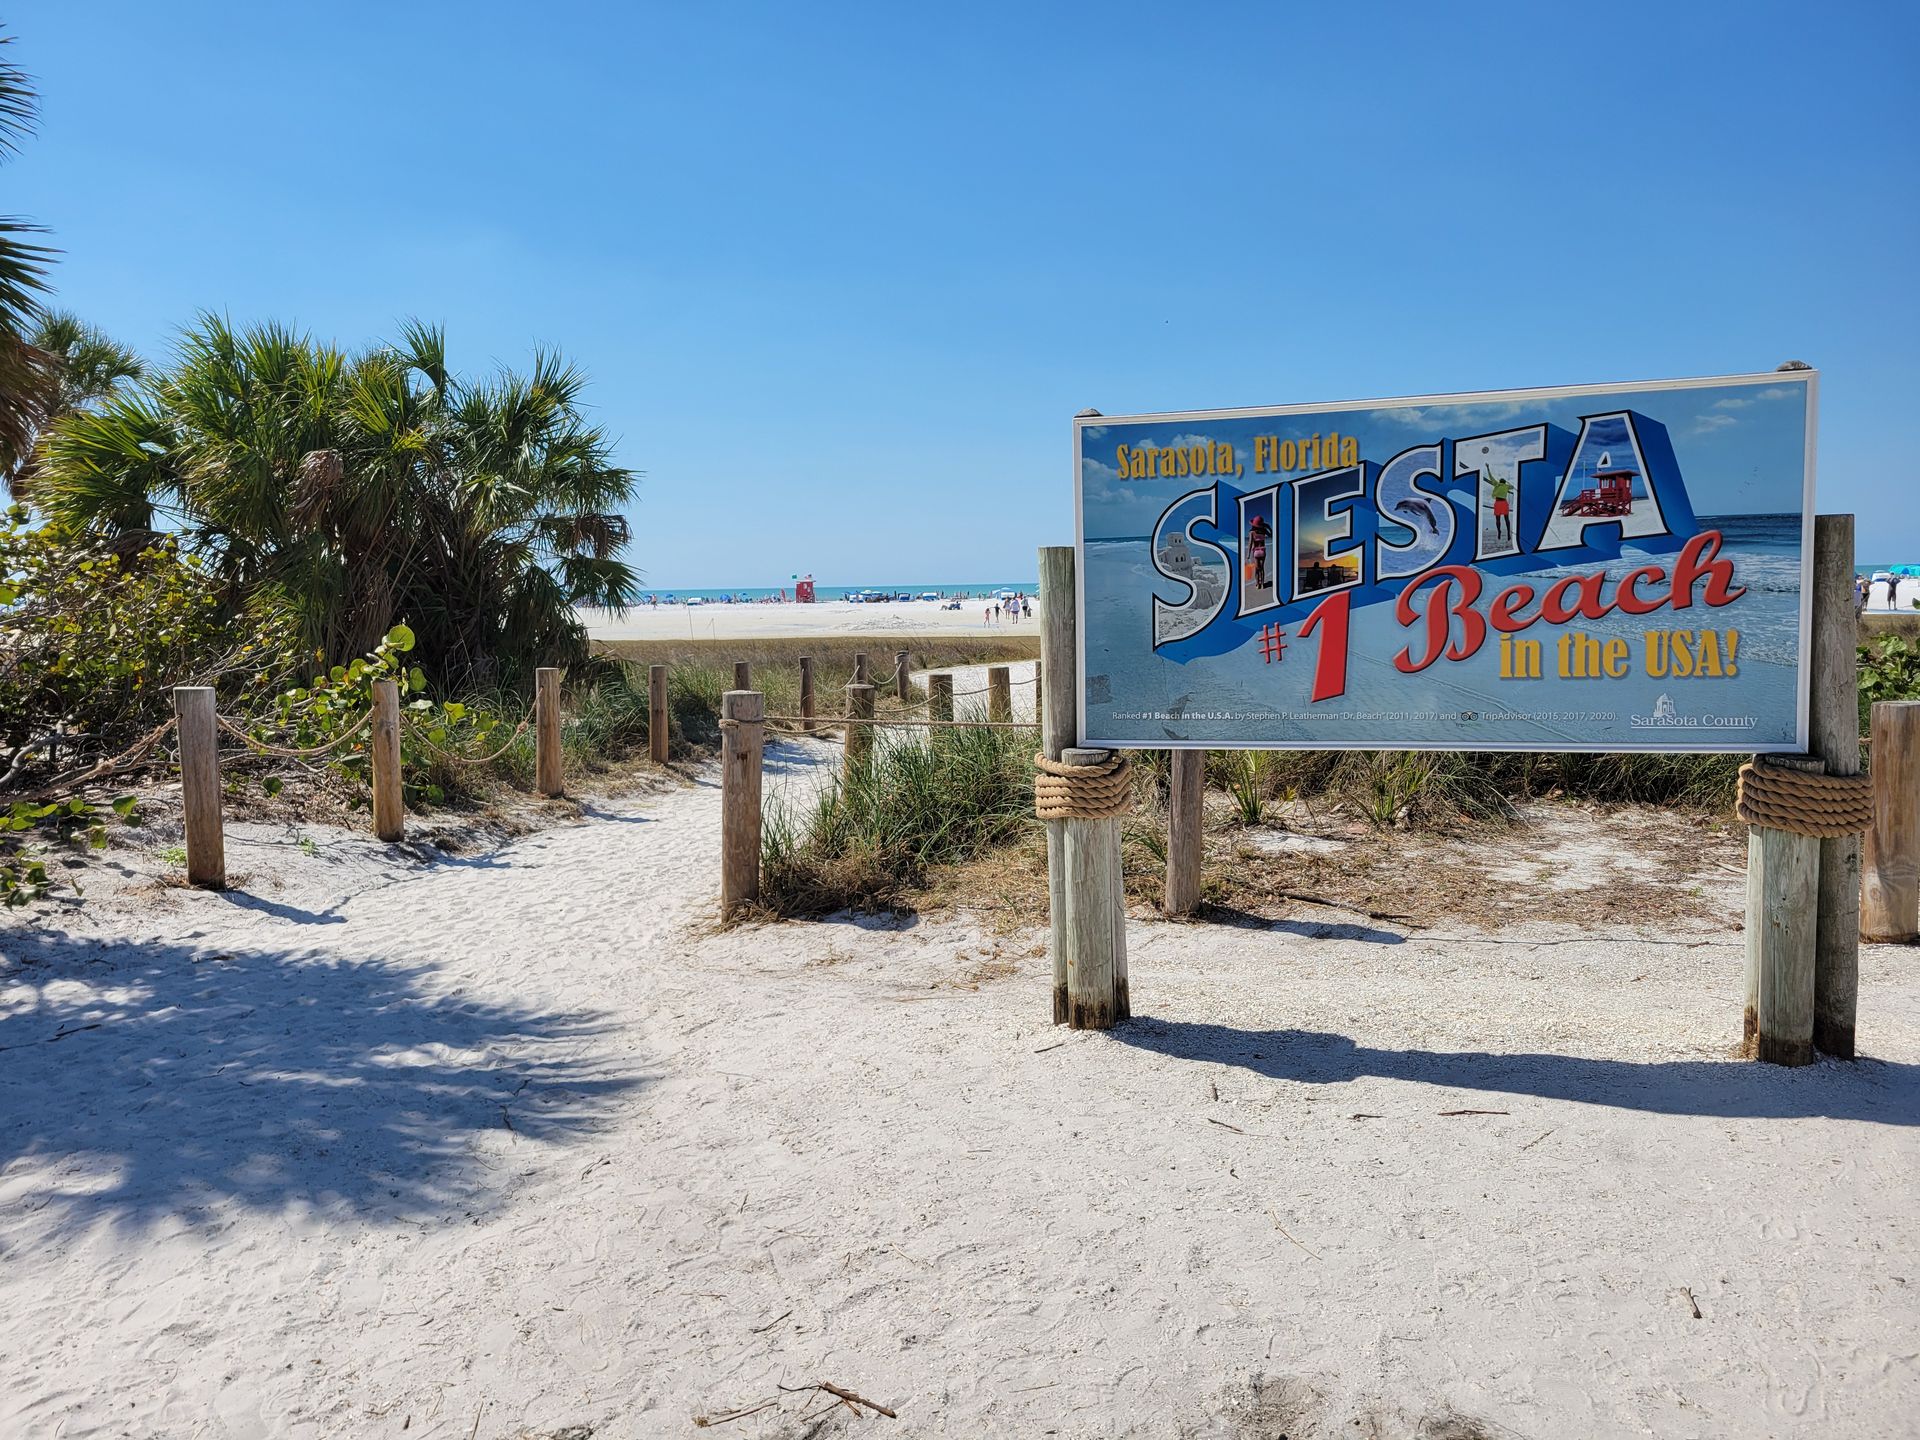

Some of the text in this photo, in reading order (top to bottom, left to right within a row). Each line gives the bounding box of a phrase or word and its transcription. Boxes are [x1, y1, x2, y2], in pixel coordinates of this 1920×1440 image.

[1117, 432, 1359, 480] Sarasota, Florida
[1152, 410, 1672, 651] SIESTA
[1257, 530, 1746, 703] #1 Beach
[1500, 629, 1739, 678] in the USA!
[1112, 711, 1141, 720] Ranked
[1142, 711, 1152, 720] #1
[1154, 711, 1180, 720] Beach
[1181, 711, 1190, 720] in
[1191, 711, 1206, 720] the
[1207, 711, 1234, 720] U.S.A.
[1235, 711, 1245, 722] by
[1246, 711, 1280, 722] Stephen
[1289, 711, 1339, 720] Leatherman
[1414, 711, 1438, 722] 2017)
[1440, 711, 1457, 720] and
[1482, 711, 1532, 722] TripAdvisor
[1630, 714, 1758, 729] Sarasota County
